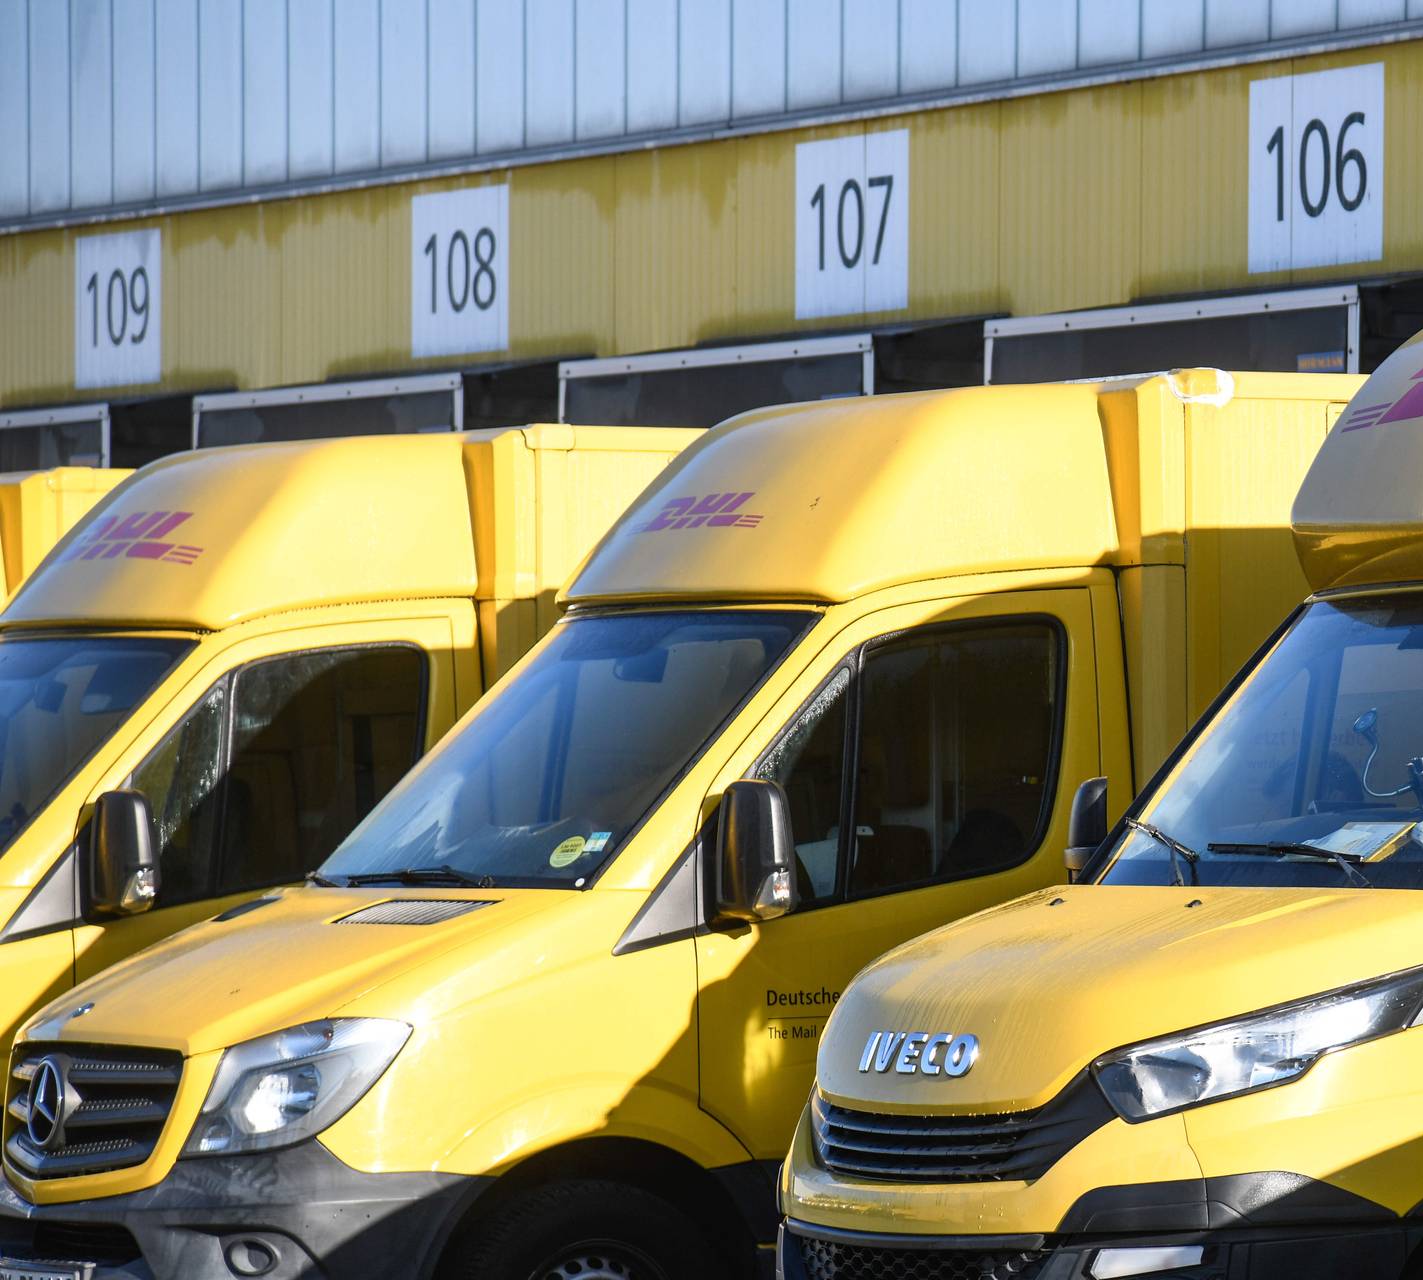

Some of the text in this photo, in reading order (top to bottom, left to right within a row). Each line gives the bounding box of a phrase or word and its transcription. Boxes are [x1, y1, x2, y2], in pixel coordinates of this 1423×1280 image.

[1266, 111, 1368, 221] 106
[809, 174, 893, 271] 107
[424, 227, 497, 314] 108
[87, 265, 150, 348] 109
[642, 492, 756, 532] DHL
[766, 987, 841, 1006] Deutsche
[768, 1026, 788, 1039] The
[792, 1025, 817, 1039] Mail
[858, 1031, 979, 1077] IVECO
